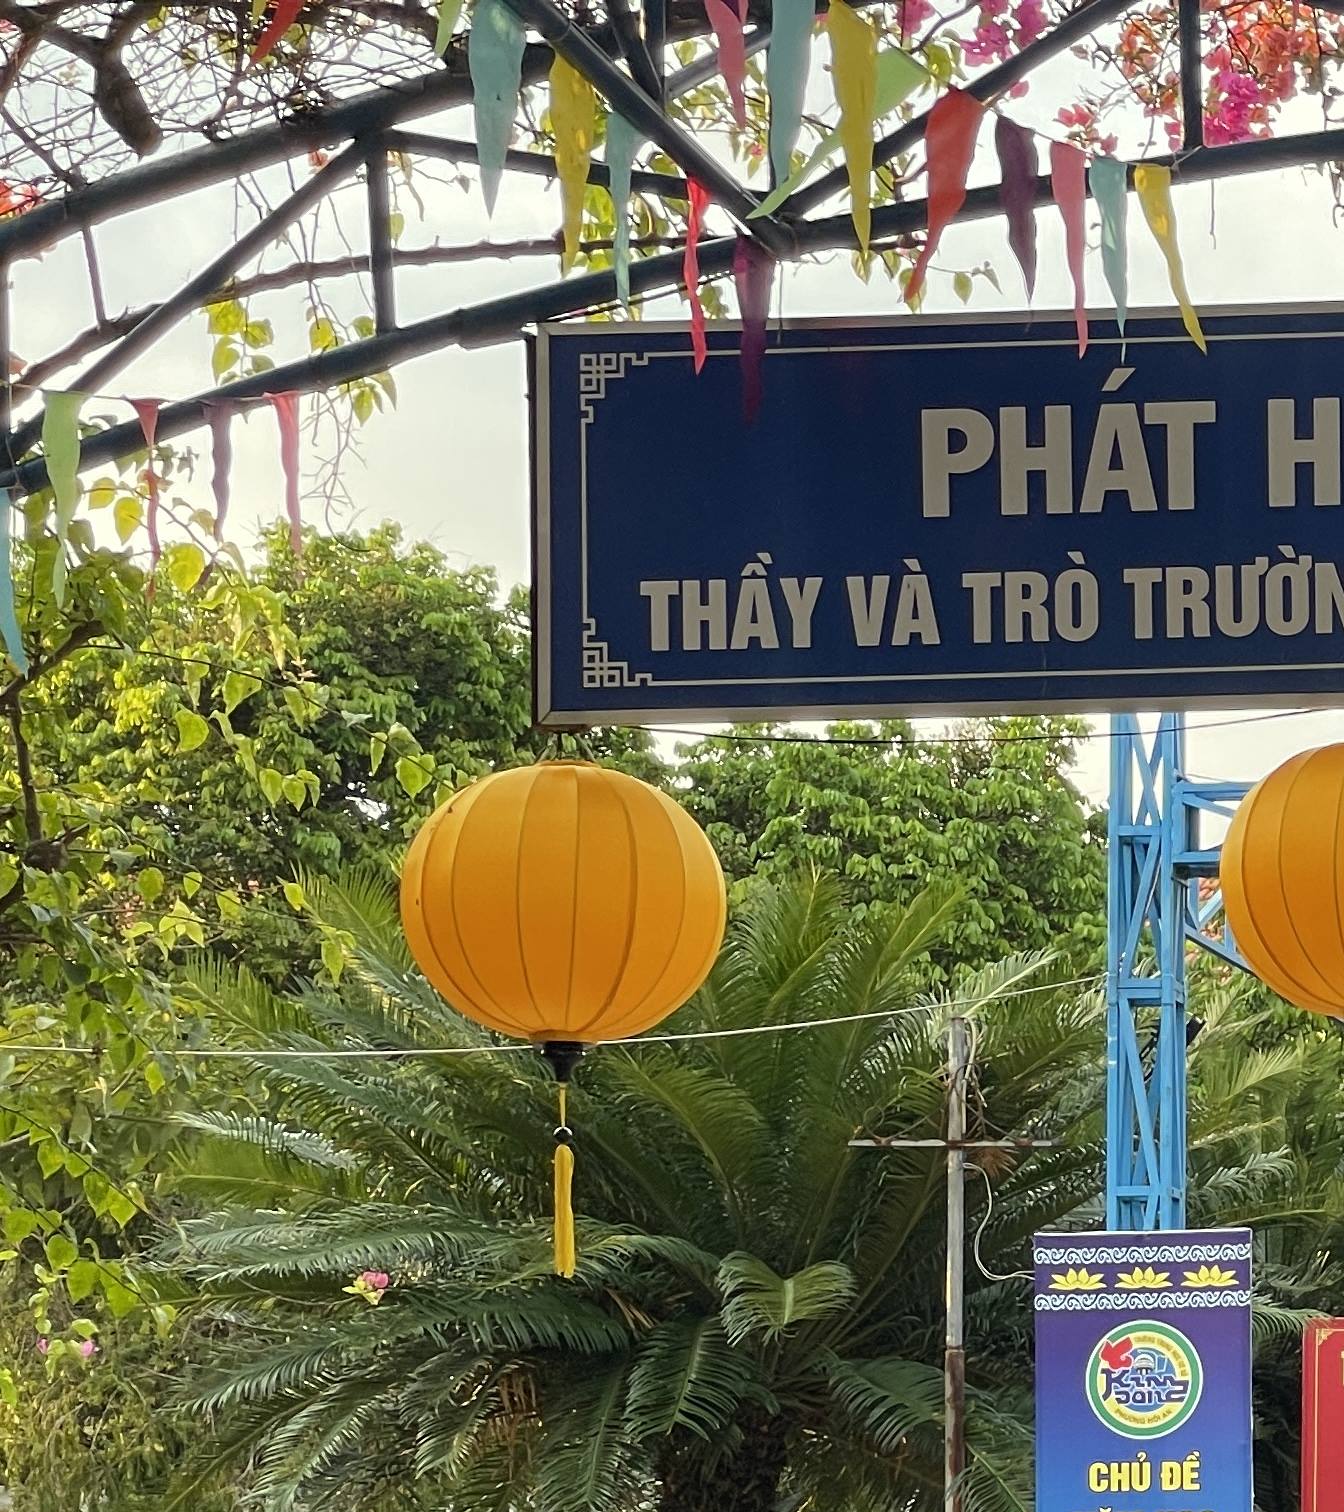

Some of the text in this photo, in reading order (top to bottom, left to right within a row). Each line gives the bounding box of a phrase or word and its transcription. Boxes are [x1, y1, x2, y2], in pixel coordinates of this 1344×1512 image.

[922, 368, 1215, 517] PHÁT
[640, 553, 822, 650] THẦY
[846, 559, 940, 646] VÀ
[962, 552, 1098, 643] TRÒ
[1088, 1447, 1201, 1492] CHỦ ĐỀ
